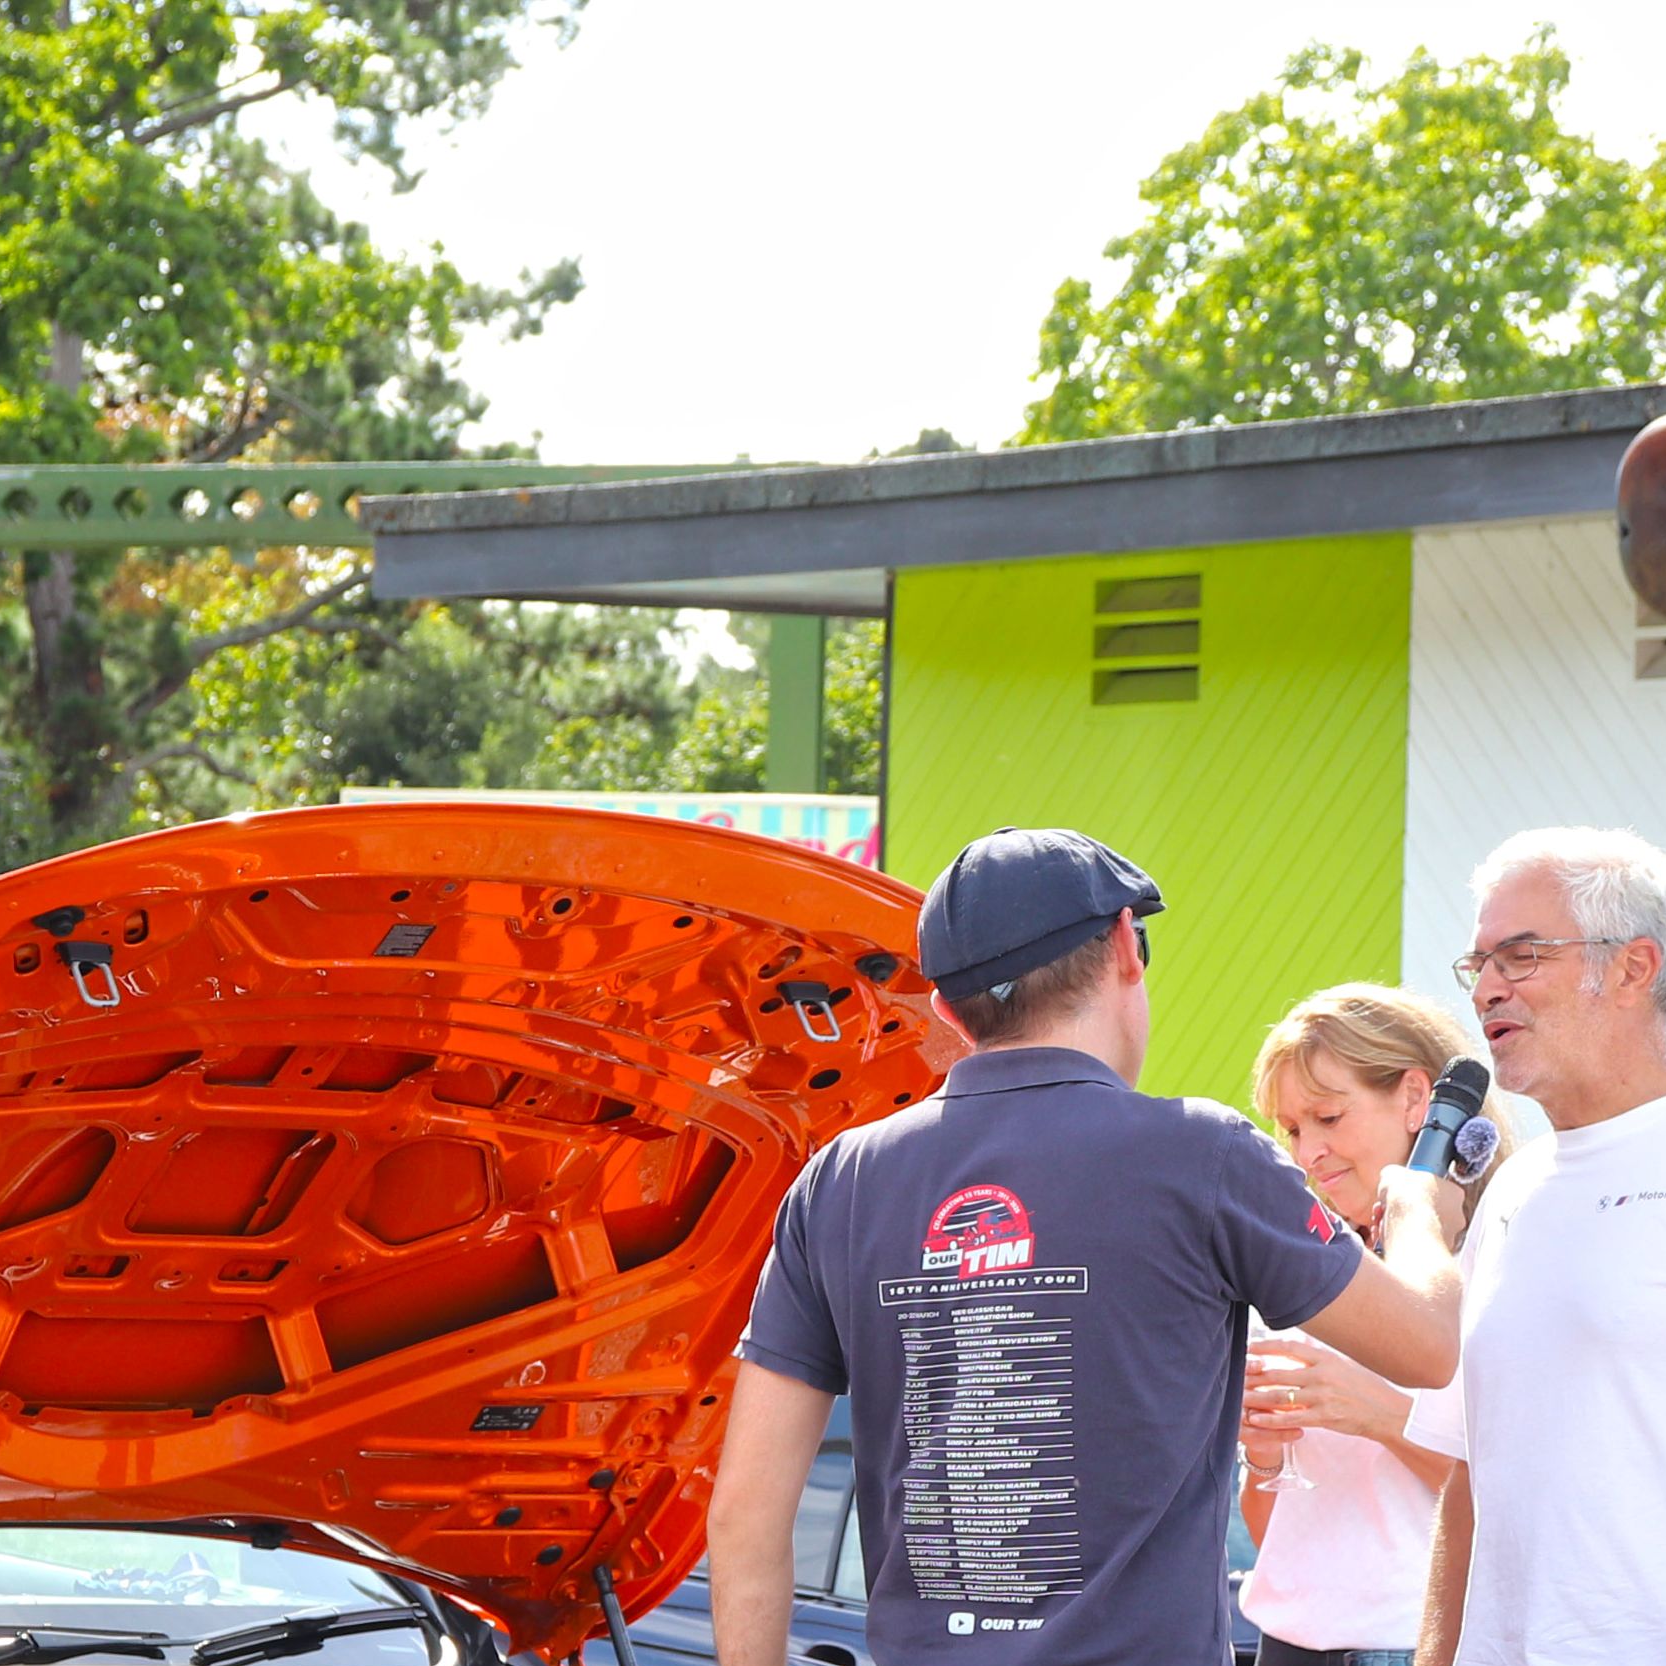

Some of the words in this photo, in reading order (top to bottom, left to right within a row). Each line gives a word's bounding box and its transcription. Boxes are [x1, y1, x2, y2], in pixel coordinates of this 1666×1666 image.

[928, 1254, 958, 1266] OUR
[964, 1238, 1031, 1274] TIM
[929, 1277, 1027, 1294] ANNIVERSARY
[1033, 1275, 1077, 1285] TOUR
[998, 1337, 1029, 1345] ROVER
[986, 1400, 1032, 1408] AMERICAN
[985, 1413, 1015, 1421] METRO
[1019, 1492, 1070, 1501] FIREPOWER
[1016, 1596, 1034, 1604] LIVE
[981, 1618, 1015, 1631] OUR
[1017, 1618, 1045, 1631] TIM
